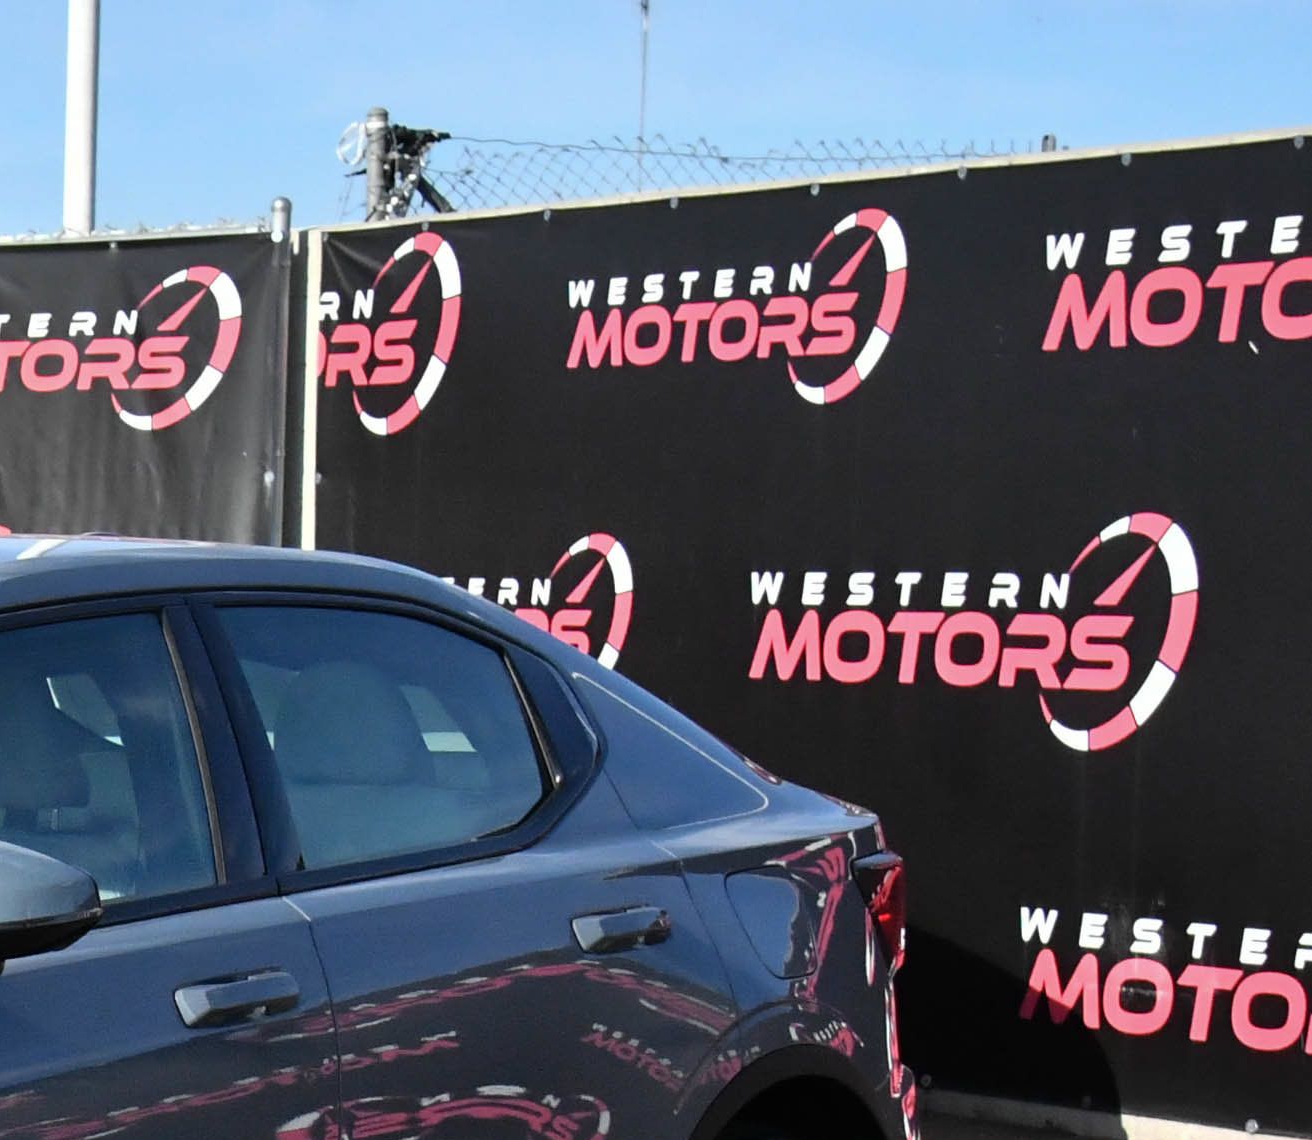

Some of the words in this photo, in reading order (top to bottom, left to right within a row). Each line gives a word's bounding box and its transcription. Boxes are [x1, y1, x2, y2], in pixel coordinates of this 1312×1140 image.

[1047, 215, 1303, 271] WESTE
[569, 262, 812, 308] WESTERN
[567, 292, 859, 368] MOTORS
[751, 571, 1070, 608] WESTERN
[749, 609, 1134, 691] MOTORS
[1018, 949, 1312, 1055] MOTO
